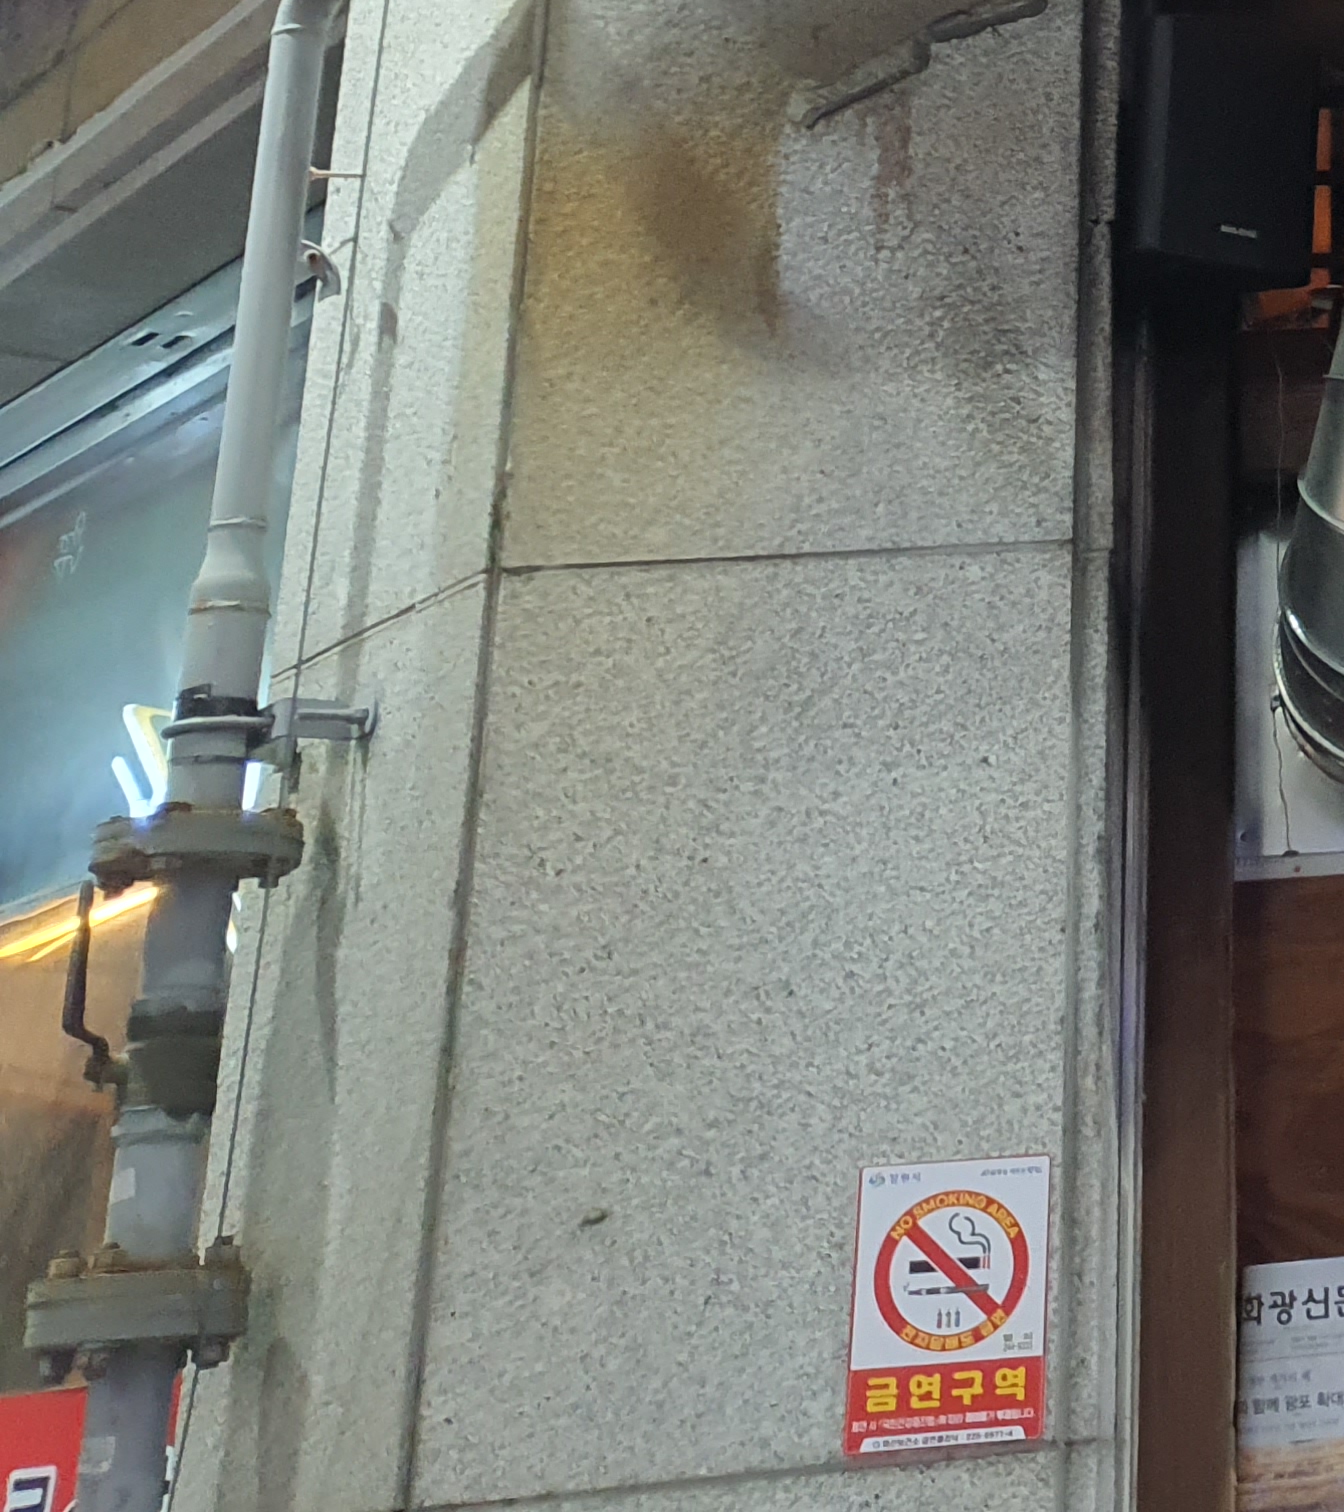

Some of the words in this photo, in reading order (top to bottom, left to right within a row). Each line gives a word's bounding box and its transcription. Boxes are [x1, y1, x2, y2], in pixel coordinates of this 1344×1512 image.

[889, 1214, 913, 1241] NO
[912, 1191, 987, 1219] SMOKING
[987, 1202, 1021, 1238] AREA
[865, 1365, 1027, 1413] 금연구역
